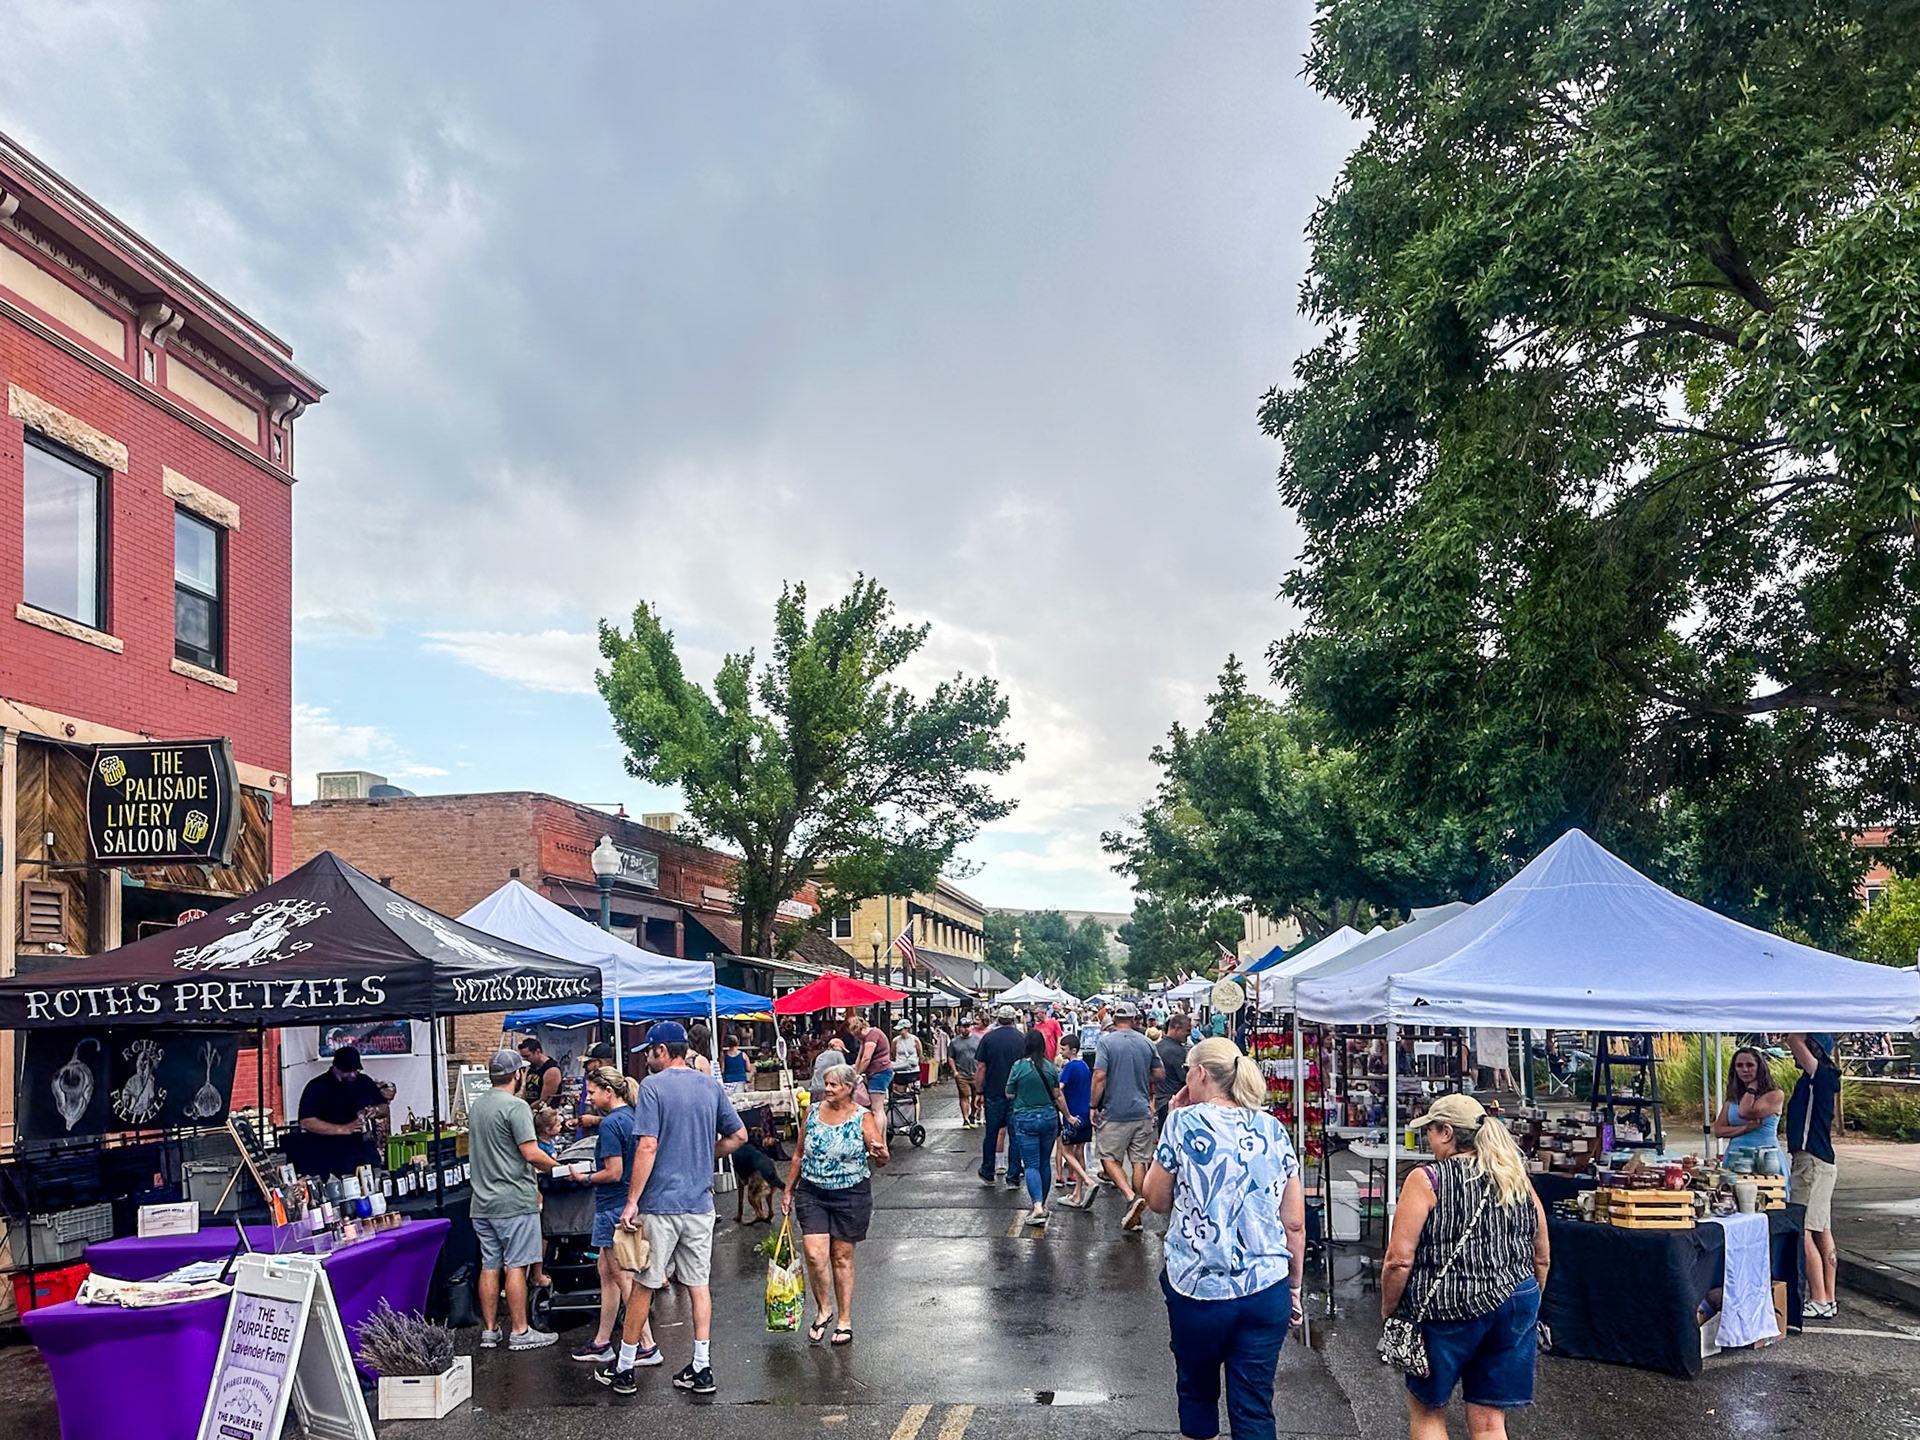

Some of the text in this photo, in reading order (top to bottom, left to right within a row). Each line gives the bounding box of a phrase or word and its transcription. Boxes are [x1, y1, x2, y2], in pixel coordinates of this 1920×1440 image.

[151, 752, 183, 775] THE
[126, 776, 208, 801] PALISADE
[107, 803, 174, 827] LIVERY
[104, 829, 177, 853] SALOON
[226, 898, 332, 925] ROTH'S
[24, 975, 388, 1020] ROTH'S PRETZELS
[516, 976, 592, 1001] PRETZELS
[110, 1087, 167, 1124] PRETZELS
[258, 1306, 276, 1323] THE
[236, 1319, 290, 1343] PURPLE BEE
[231, 1340, 286, 1364] Lavender Farm
[223, 1376, 273, 1405] APIARIES AND APOTHECARY
[217, 1411, 263, 1431] THE PURPLE BEE
